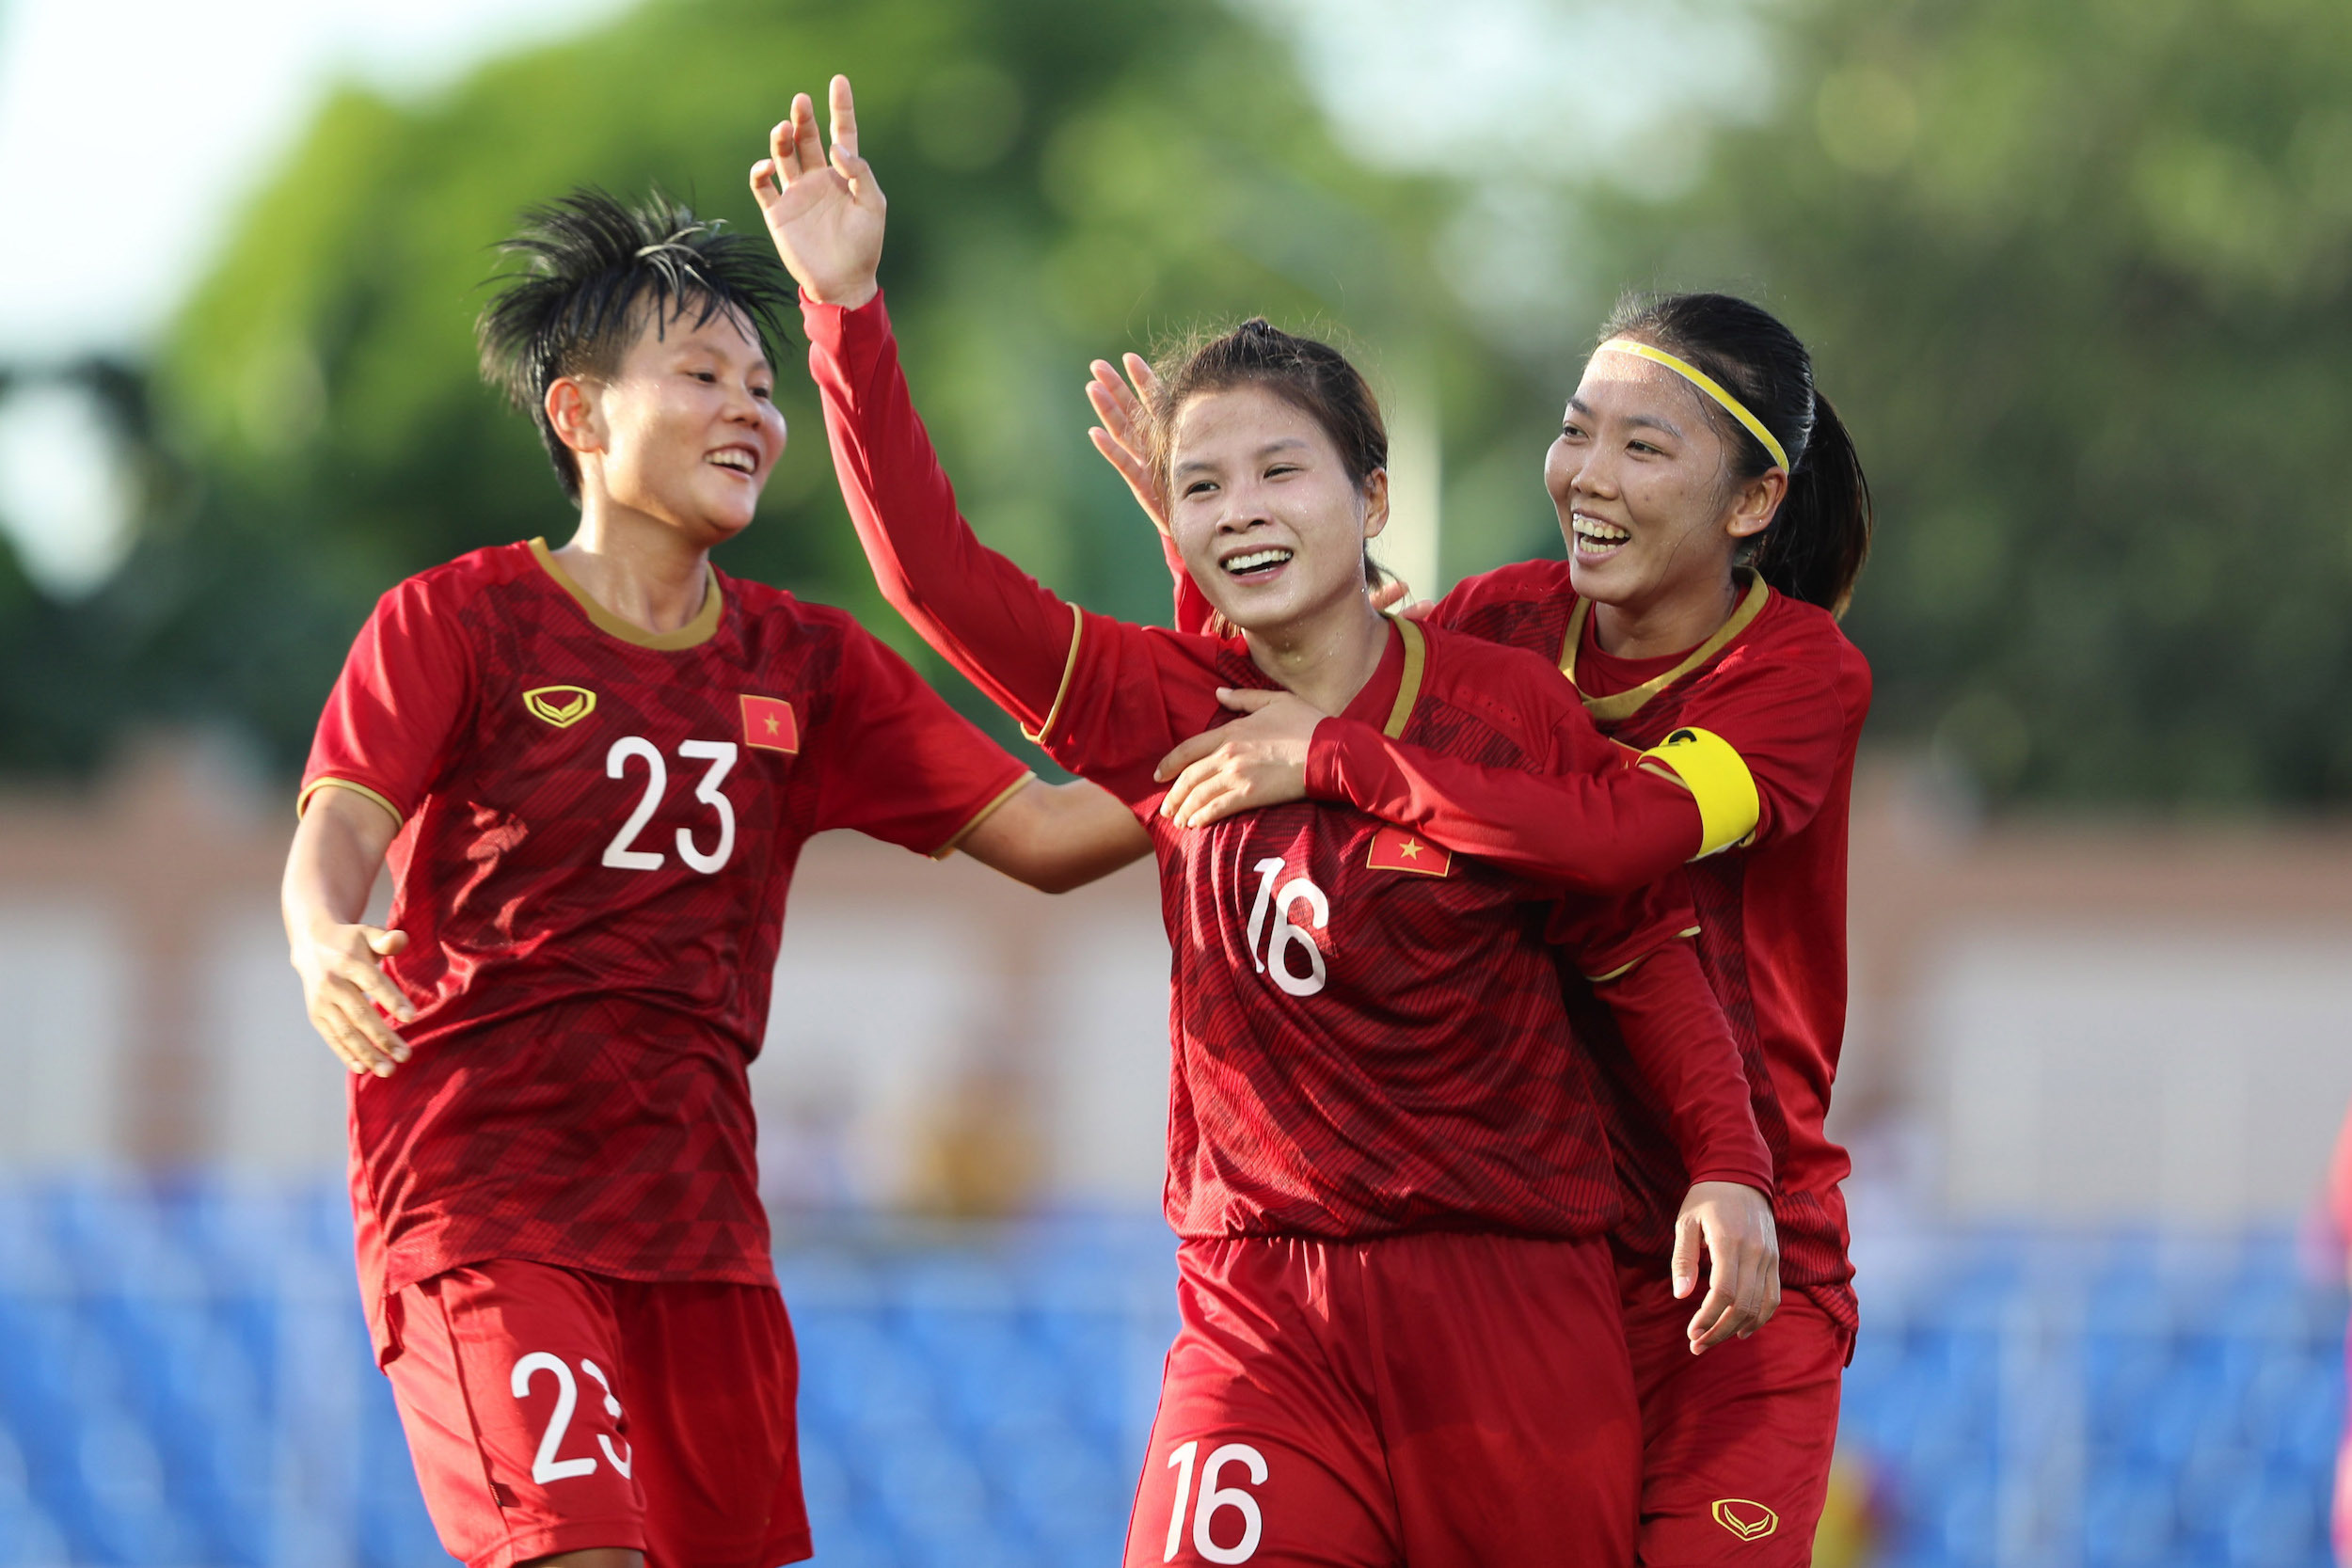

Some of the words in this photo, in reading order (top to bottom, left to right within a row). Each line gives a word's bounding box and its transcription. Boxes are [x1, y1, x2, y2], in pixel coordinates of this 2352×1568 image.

[602, 736, 738, 874] 23
[1247, 857, 1329, 997] 16
[1163, 1441, 1269, 1565] 16
